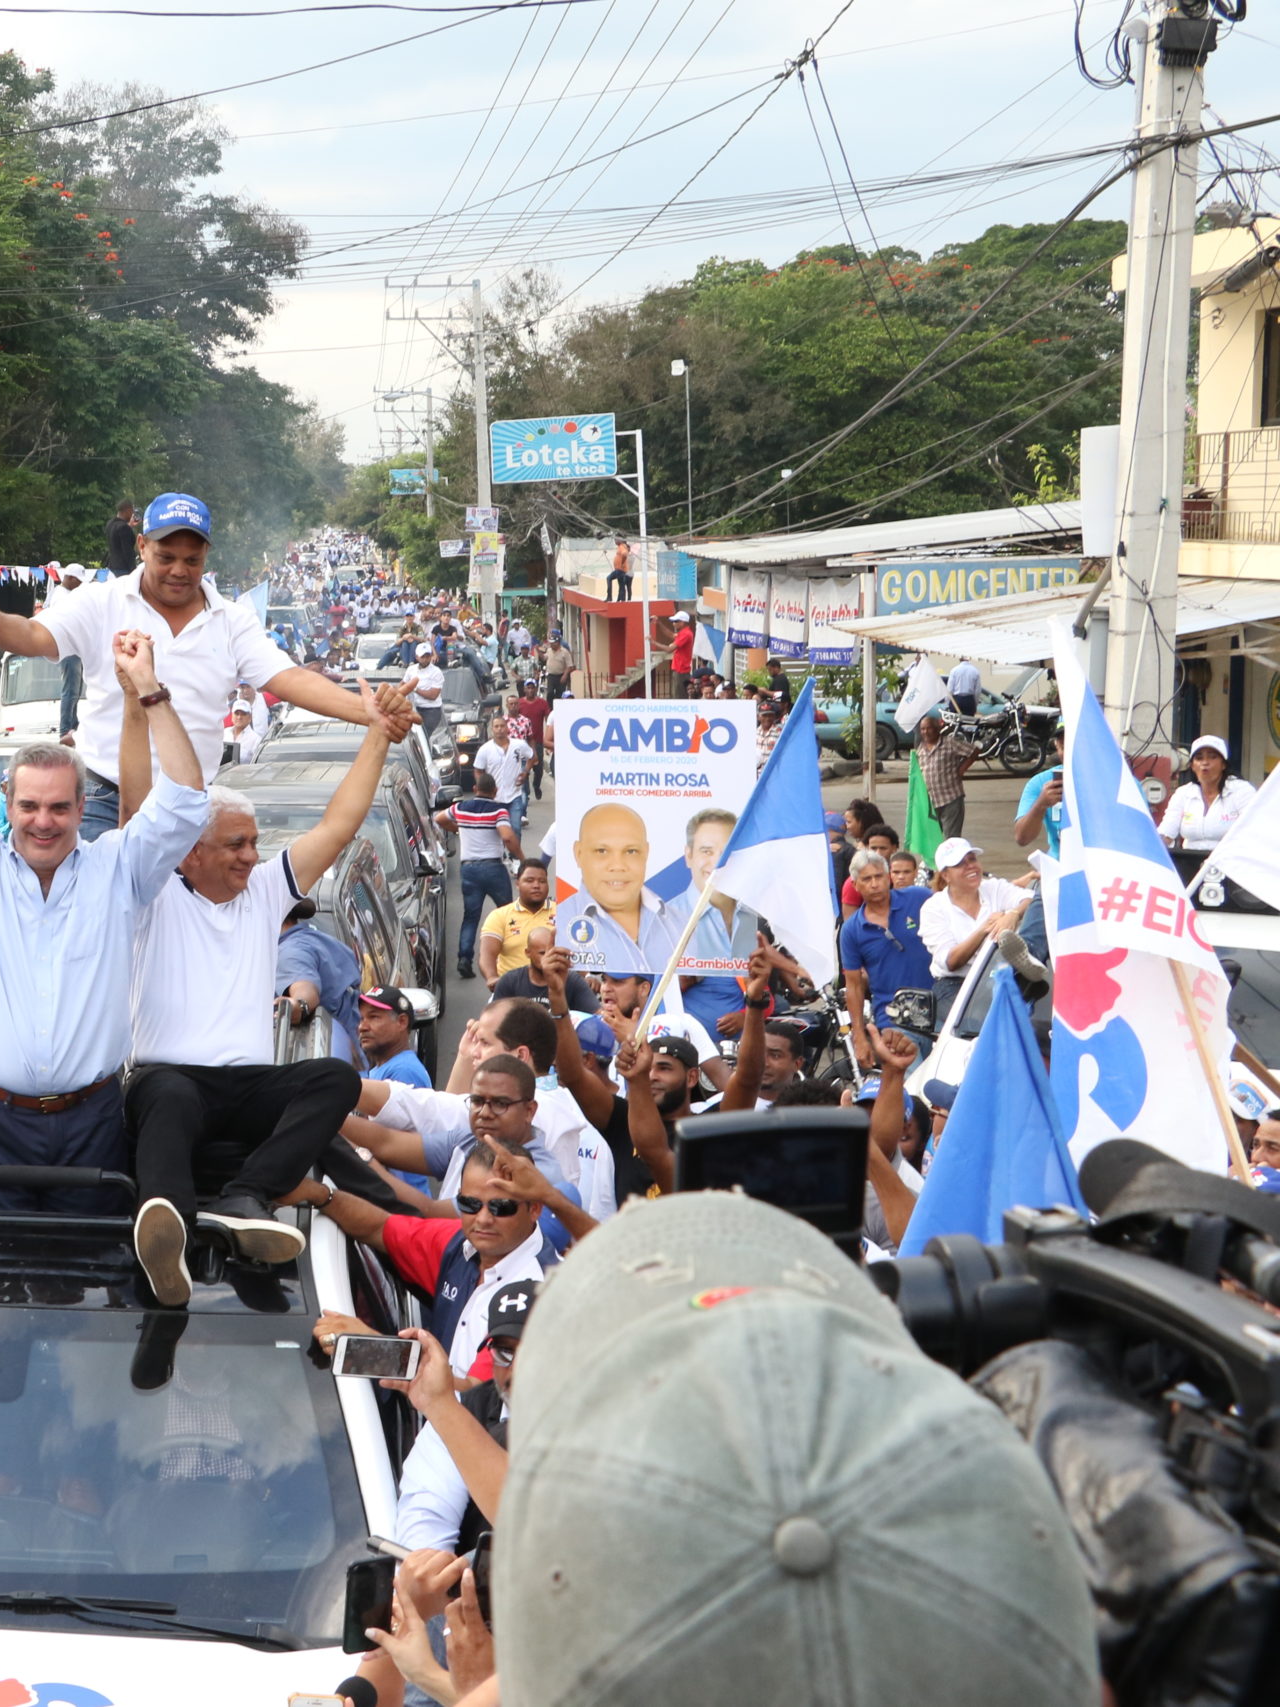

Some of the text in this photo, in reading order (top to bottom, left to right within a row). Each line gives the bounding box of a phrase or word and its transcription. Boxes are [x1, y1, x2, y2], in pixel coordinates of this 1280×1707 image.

[505, 440, 606, 469] Loteka
[557, 464, 606, 477] te toca
[605, 704, 700, 713] CONTIGO HAREMOS EL
[569, 713, 738, 754] CAMBIO
[621, 755, 632, 764] DE
[634, 755, 674, 765] FEBRERO
[676, 756, 698, 765] 2020
[600, 771, 710, 788] MARTIN ROSA
[596, 788, 713, 798] DIRECTOR COMEDERO ARRIBA
[568, 951, 606, 965] OTA 2
